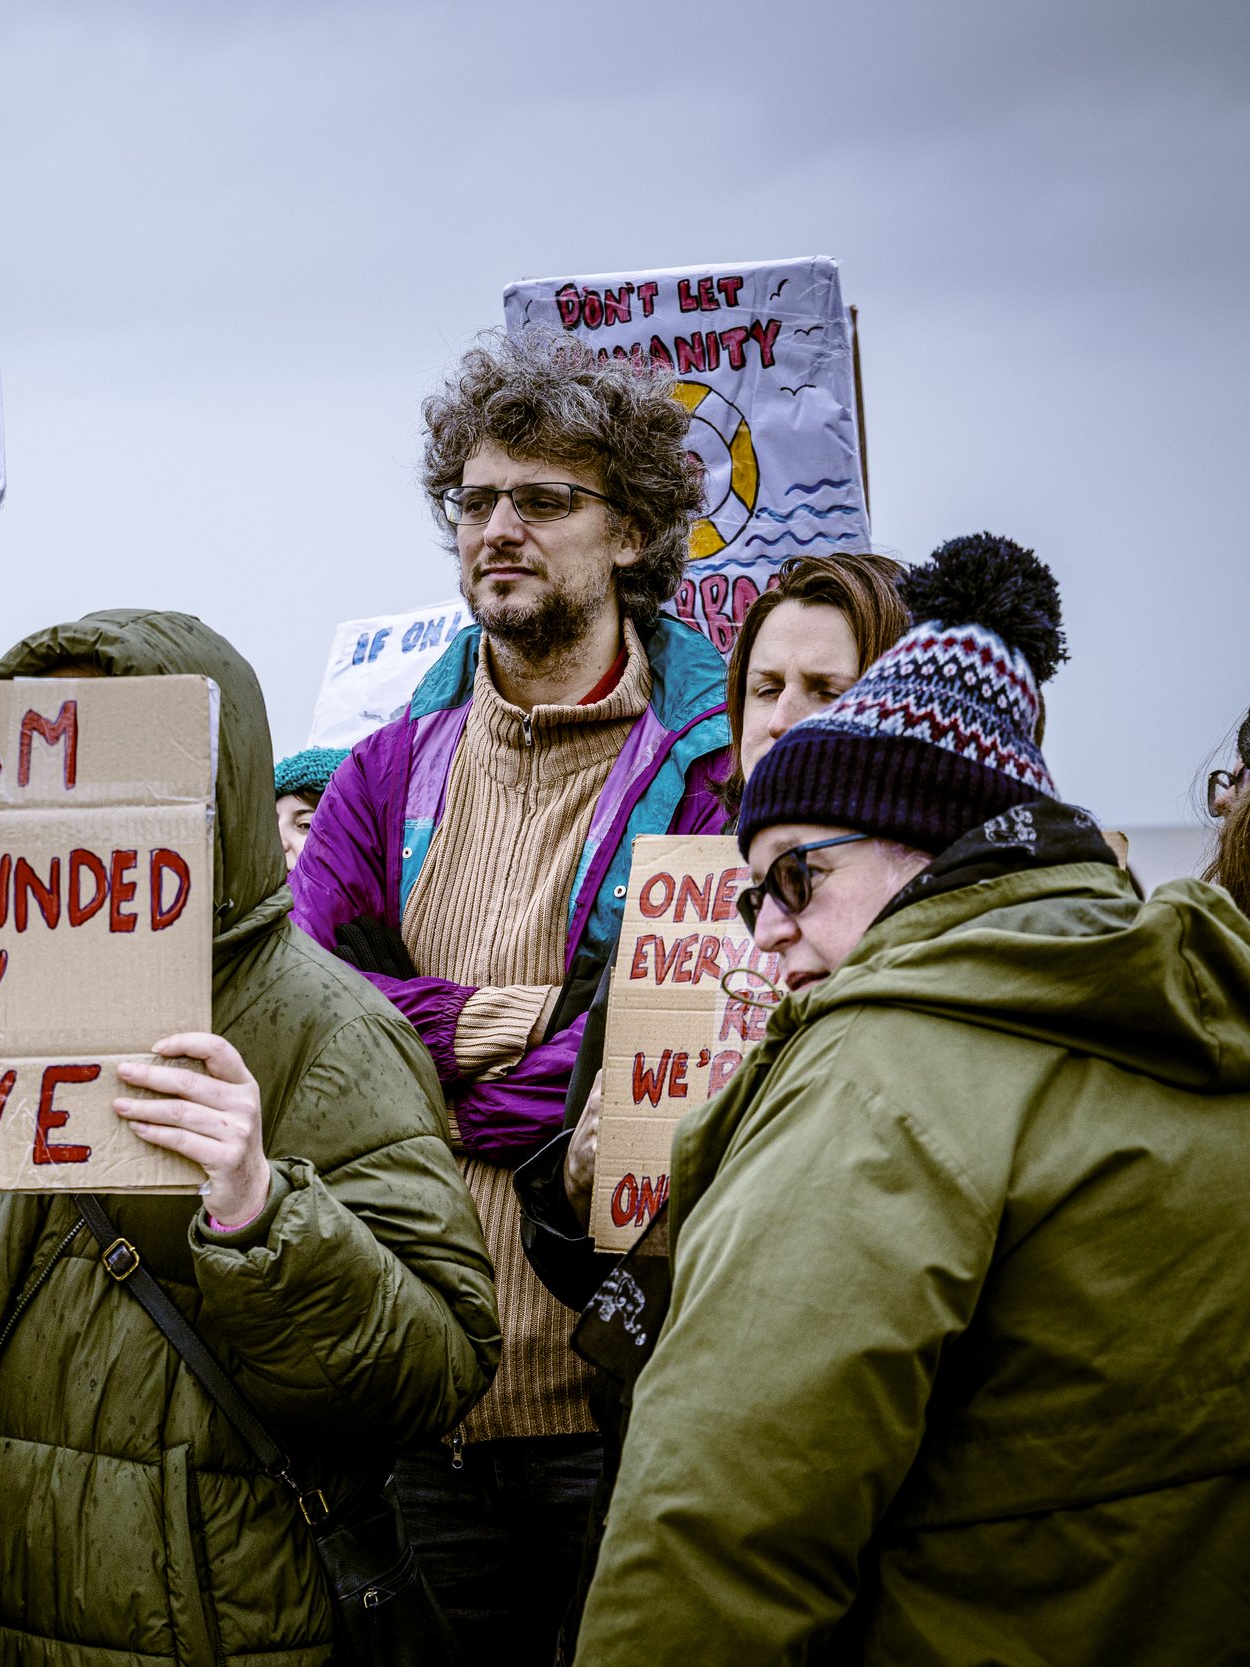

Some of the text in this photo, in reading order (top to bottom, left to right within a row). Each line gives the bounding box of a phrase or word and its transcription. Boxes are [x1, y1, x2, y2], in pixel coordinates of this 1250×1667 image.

[555, 276, 743, 331] DON'T LET
[352, 627, 393, 665] IF
[639, 867, 750, 923] ONE
[629, 933, 781, 989] EVERYO
[632, 1049, 743, 1108] WE'R
